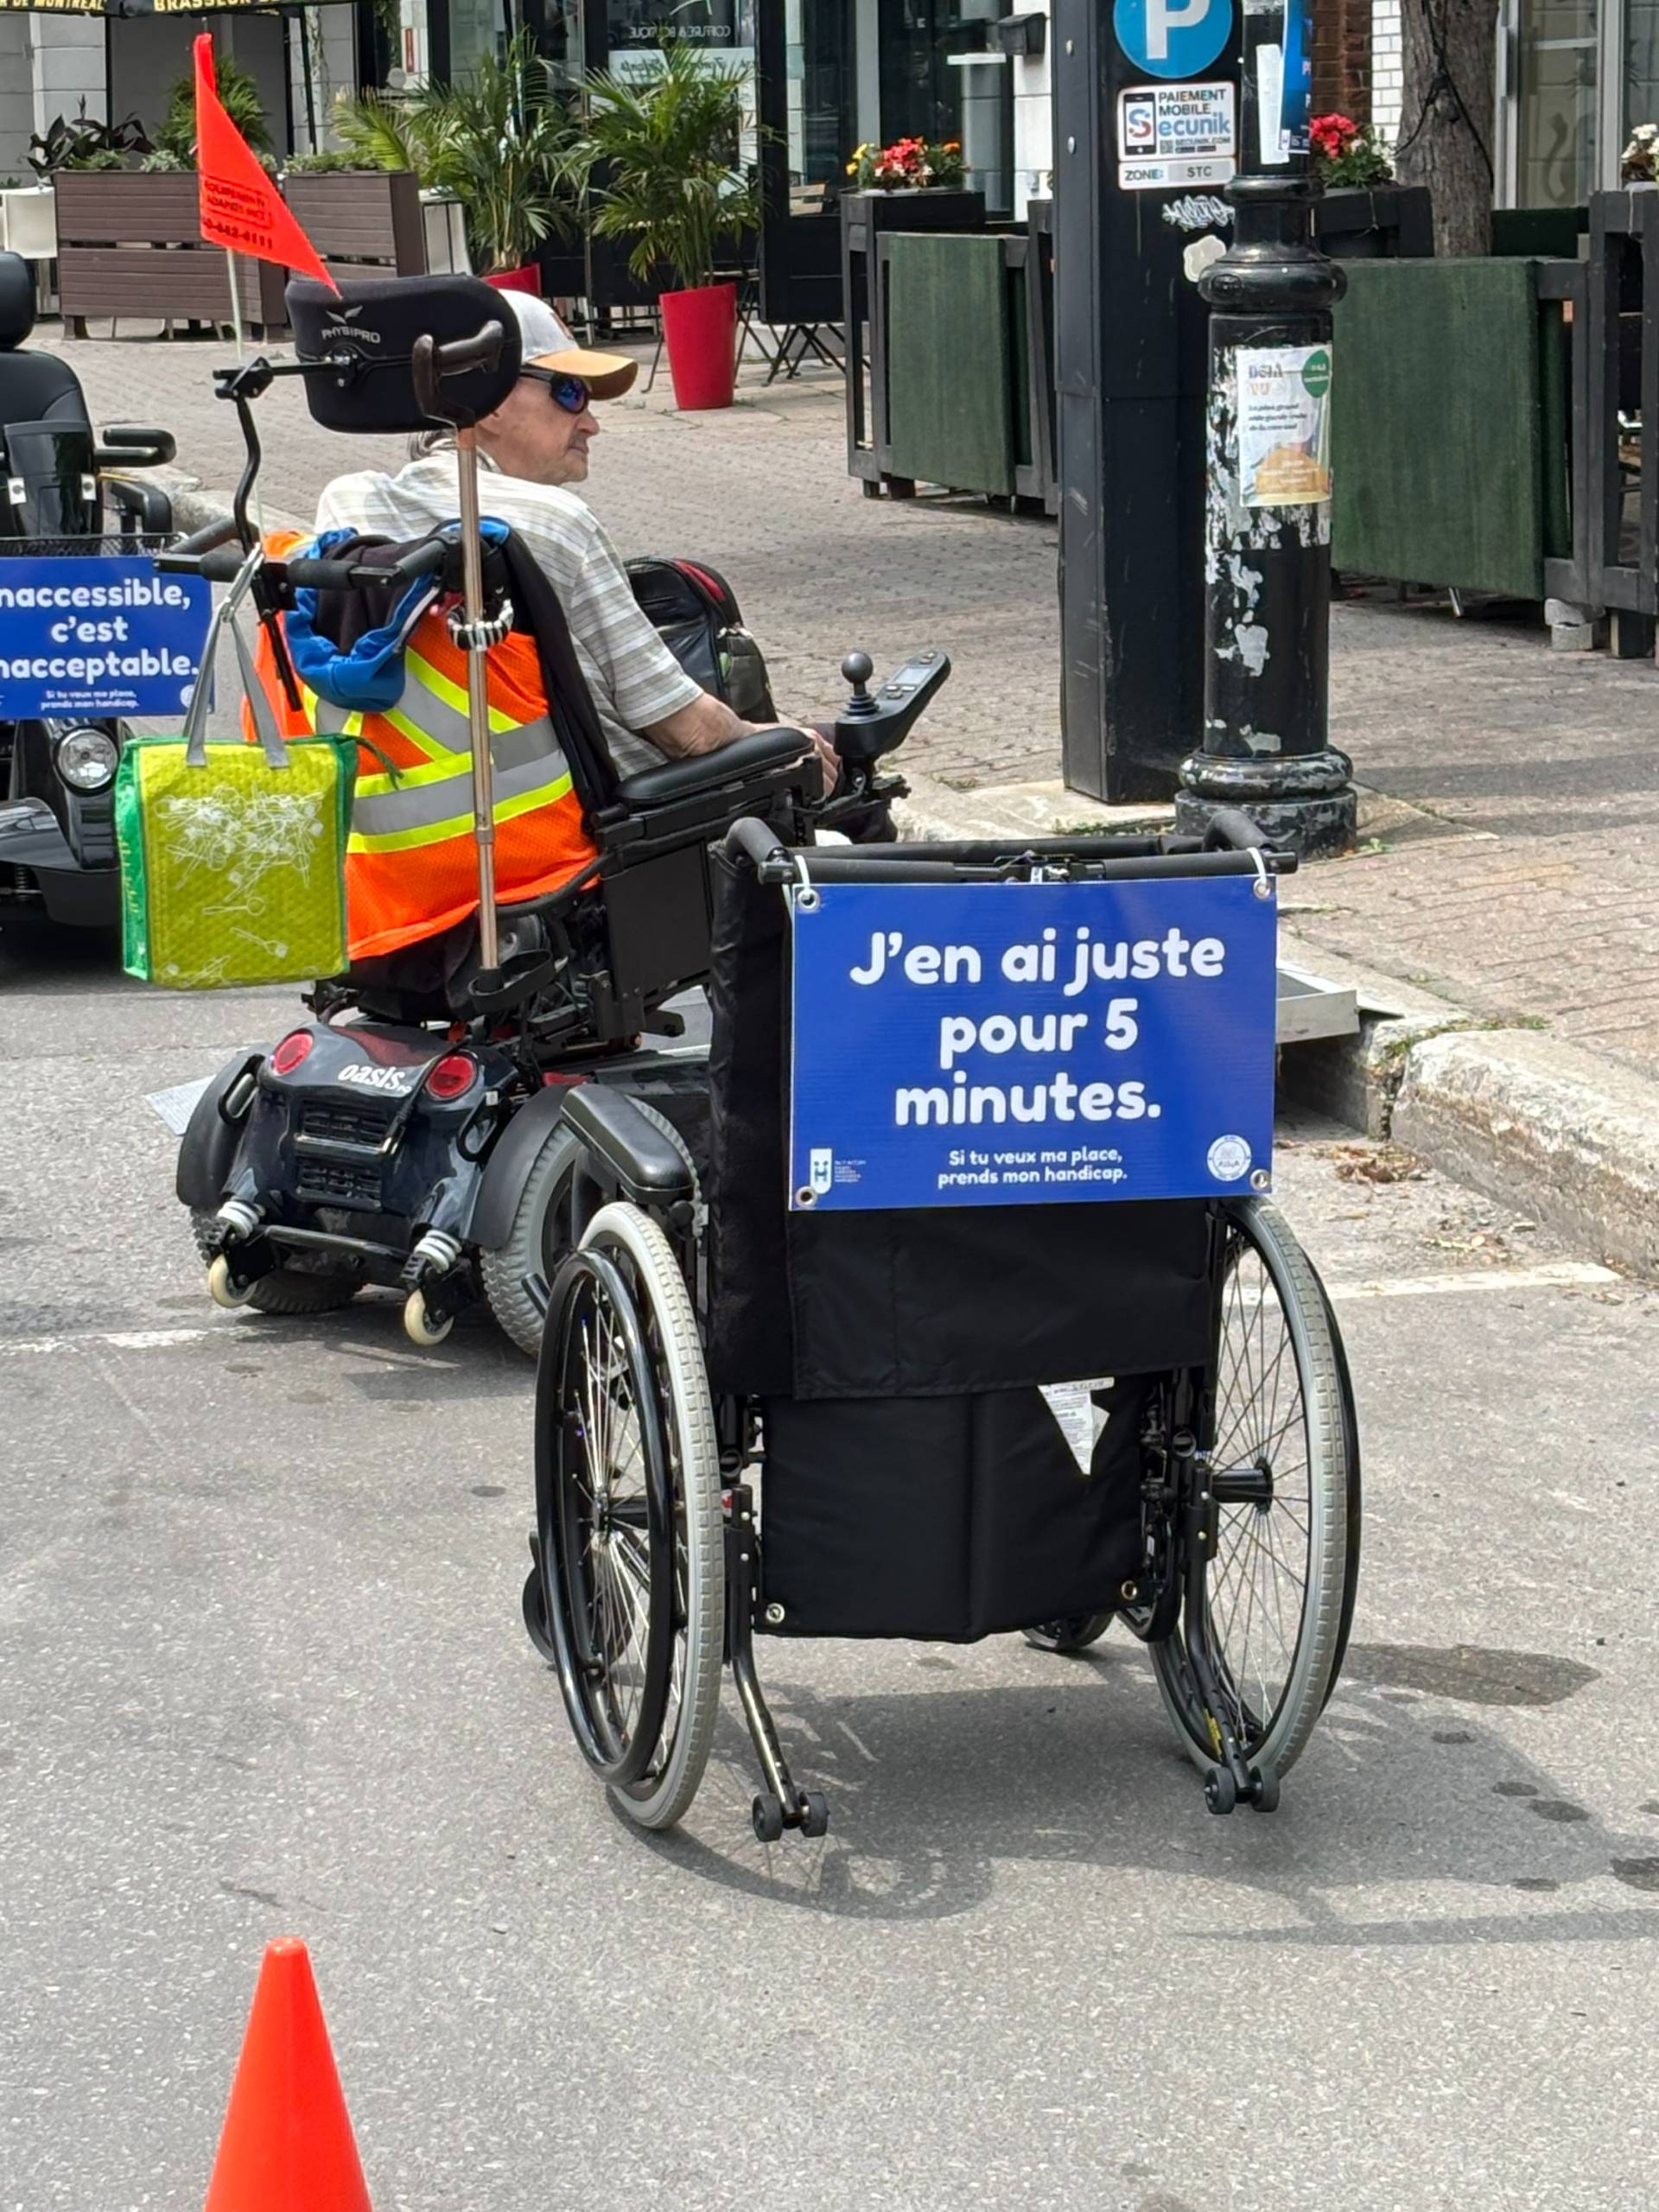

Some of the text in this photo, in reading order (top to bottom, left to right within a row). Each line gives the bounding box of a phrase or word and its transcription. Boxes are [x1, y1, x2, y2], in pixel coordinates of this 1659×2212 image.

[1146, 0, 1210, 60] P
[1159, 89, 1227, 103] PAIEMENT
[1159, 103, 1212, 117] MOBILE
[1186, 166, 1212, 178] STC
[321, 326, 381, 344] PHYSIPRO
[51, 615, 129, 643] c’est
[850, 926, 1225, 996] J’en ai juste
[940, 998, 1139, 1070] pour 5
[895, 1071, 1162, 1126] minutes.
[949, 1146, 1122, 1166] Si tu veux ma place,
[938, 1165, 1128, 1189] prends mon handicap.
